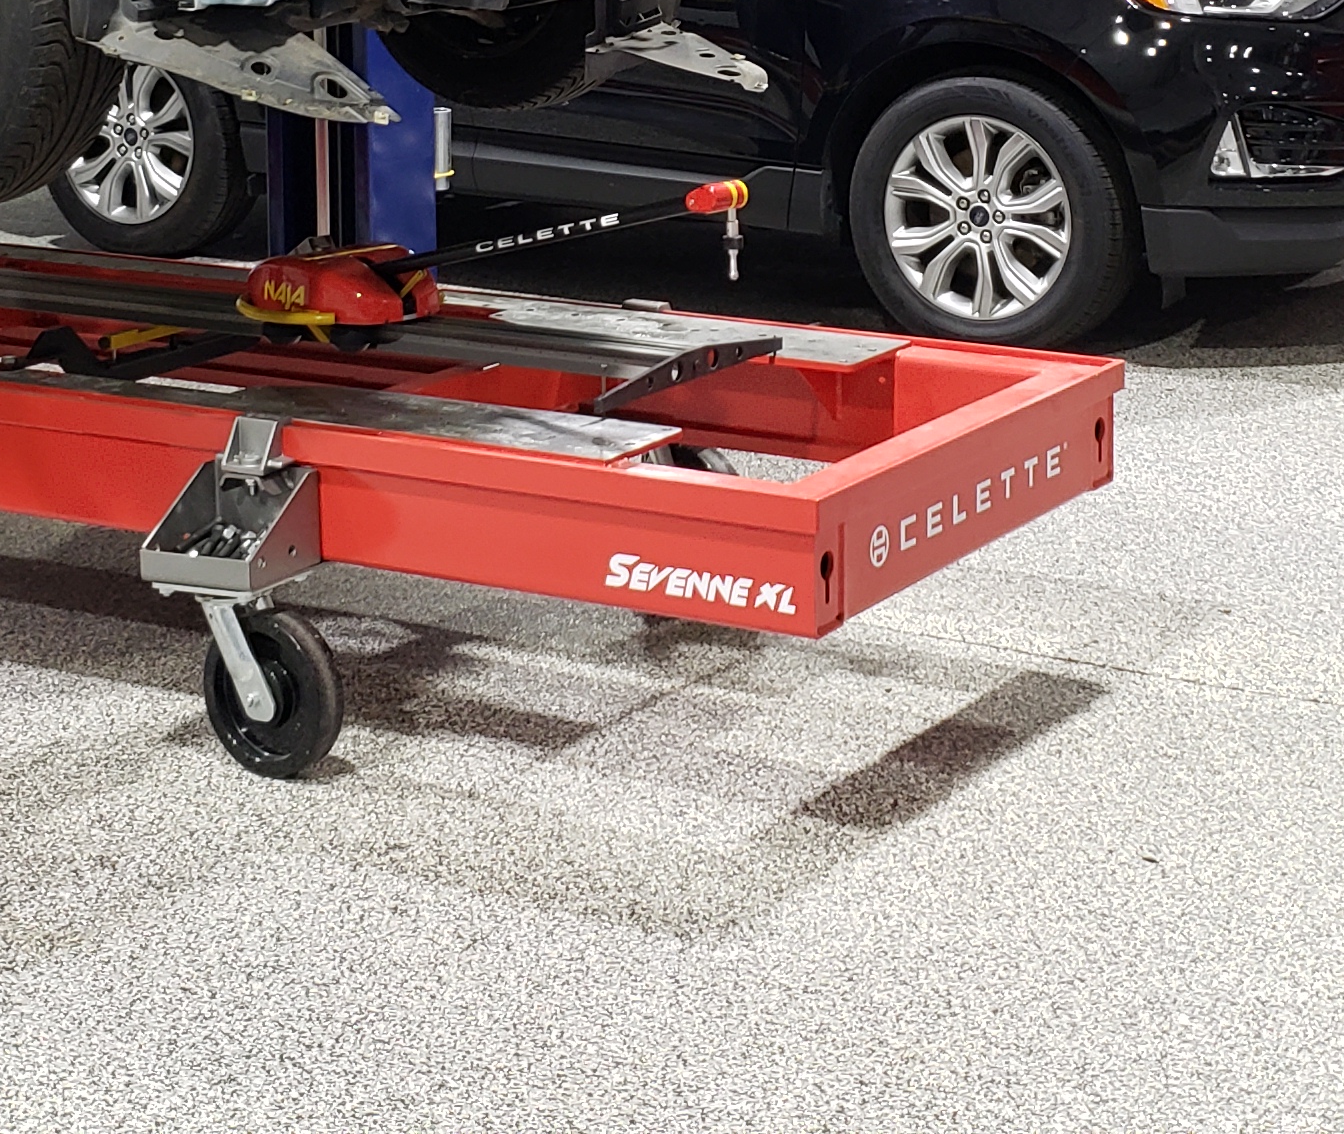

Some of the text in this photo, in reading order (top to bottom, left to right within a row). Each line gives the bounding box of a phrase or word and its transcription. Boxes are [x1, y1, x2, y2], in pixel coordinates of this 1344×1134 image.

[475, 212, 621, 253] CELETTE
[263, 278, 306, 310] NAJA
[899, 444, 1061, 552] CELETTE
[605, 552, 798, 616] SEVENNE XL
